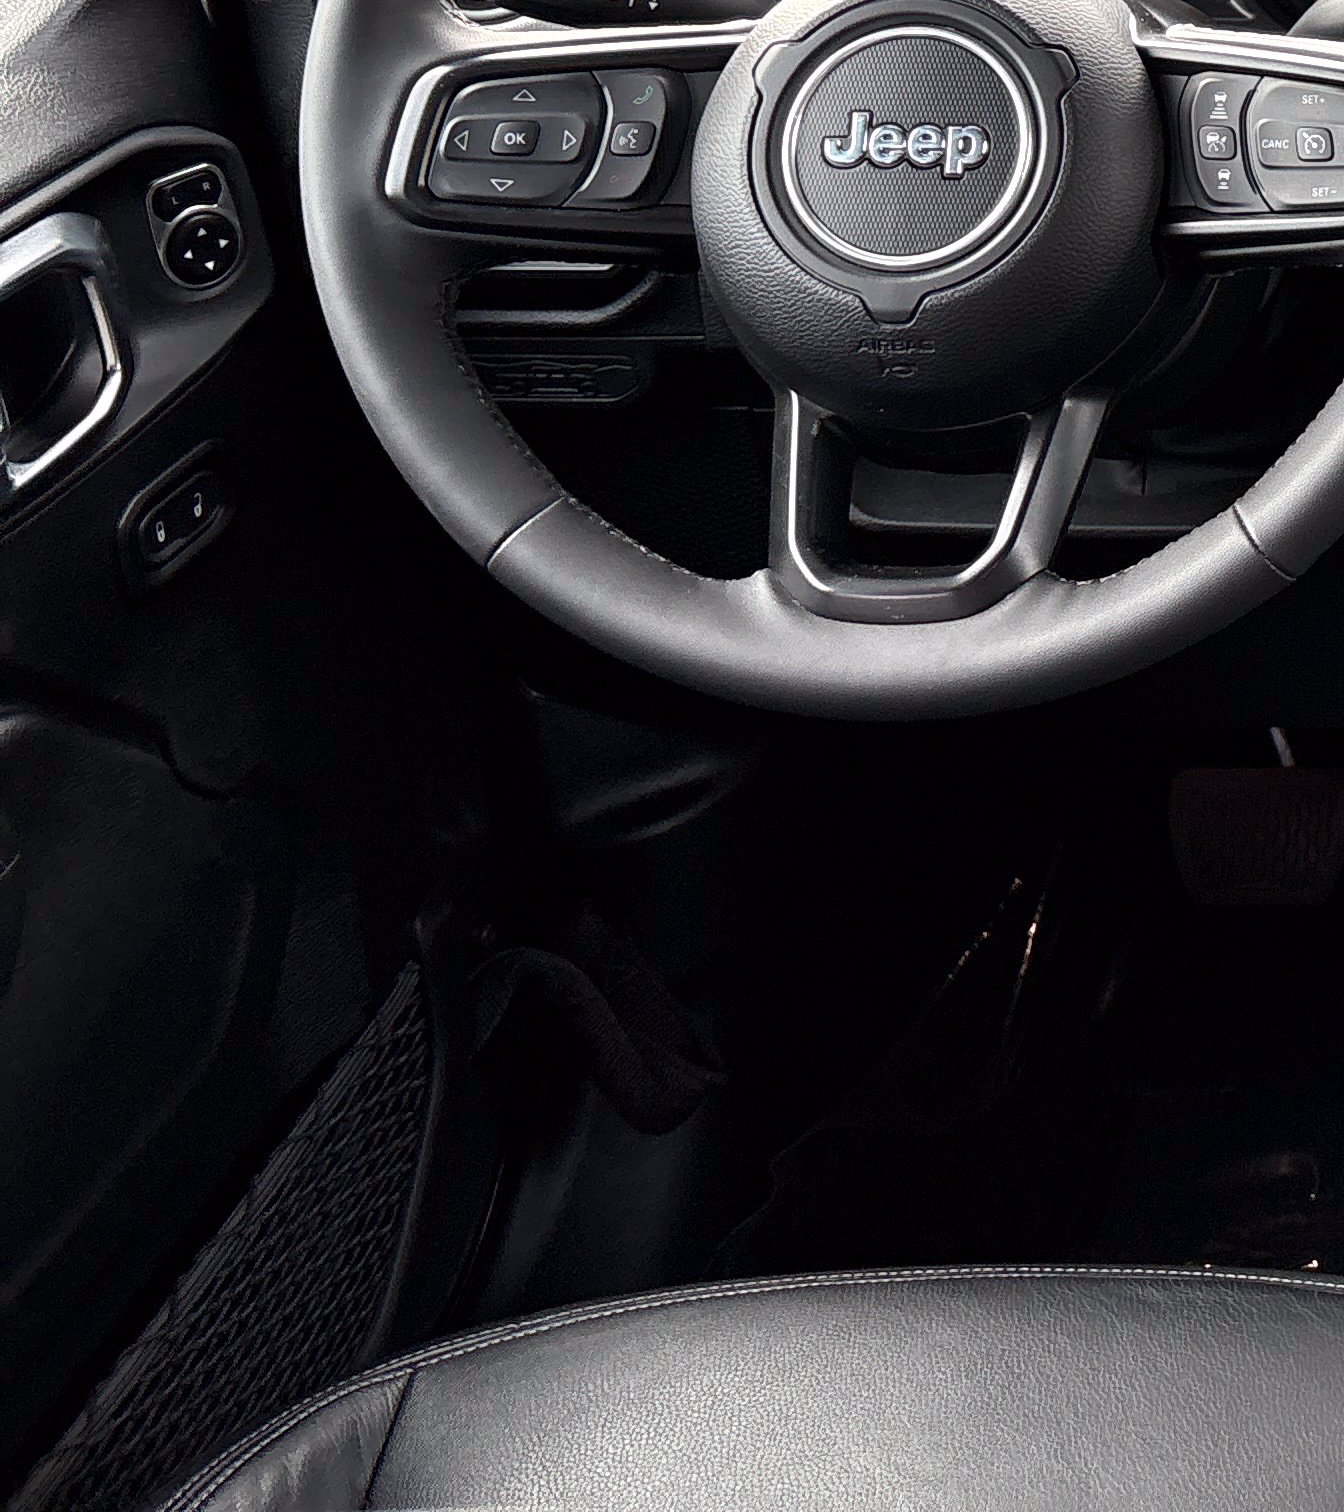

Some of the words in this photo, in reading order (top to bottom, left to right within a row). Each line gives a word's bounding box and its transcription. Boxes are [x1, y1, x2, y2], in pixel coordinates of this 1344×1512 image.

[1301, 92, 1327, 106] SET+
[502, 131, 528, 147] OK
[822, 109, 991, 180] Jeep
[1261, 137, 1290, 150] CANC
